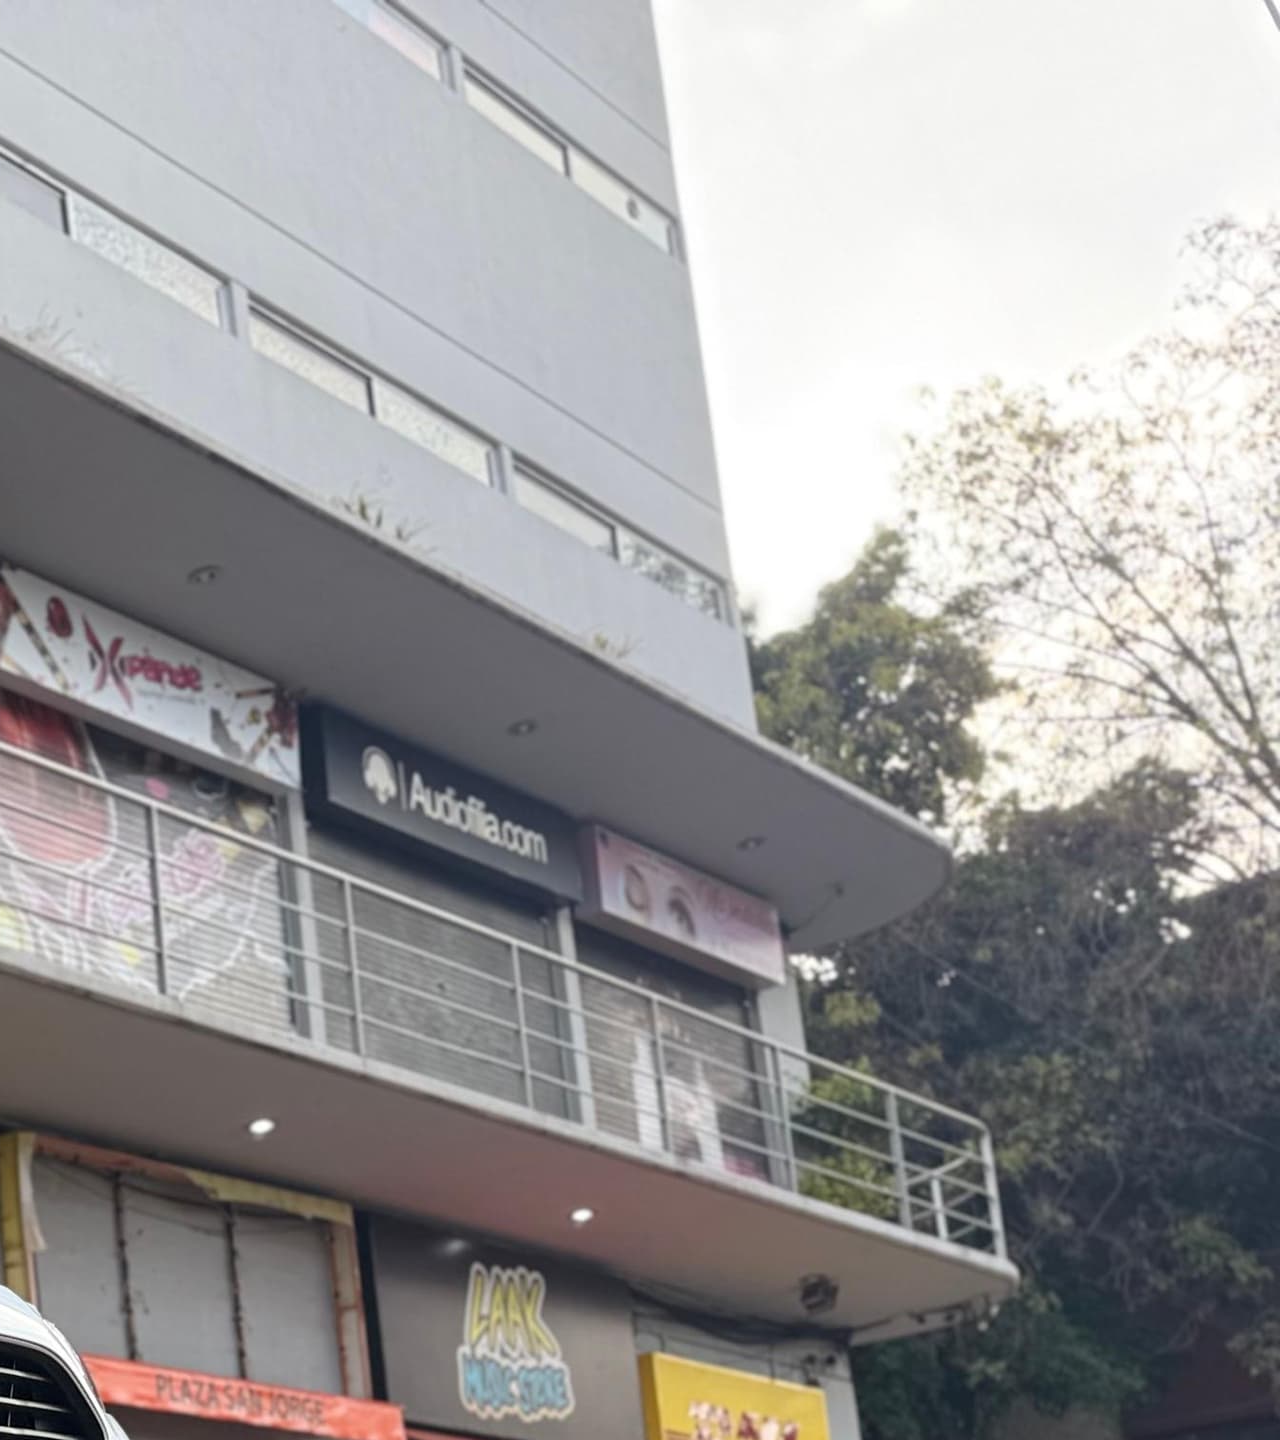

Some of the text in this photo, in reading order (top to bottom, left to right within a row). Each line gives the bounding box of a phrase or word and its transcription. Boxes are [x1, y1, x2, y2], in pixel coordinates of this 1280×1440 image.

[155, 1373, 324, 1427] PLAZA SAN JORGE
